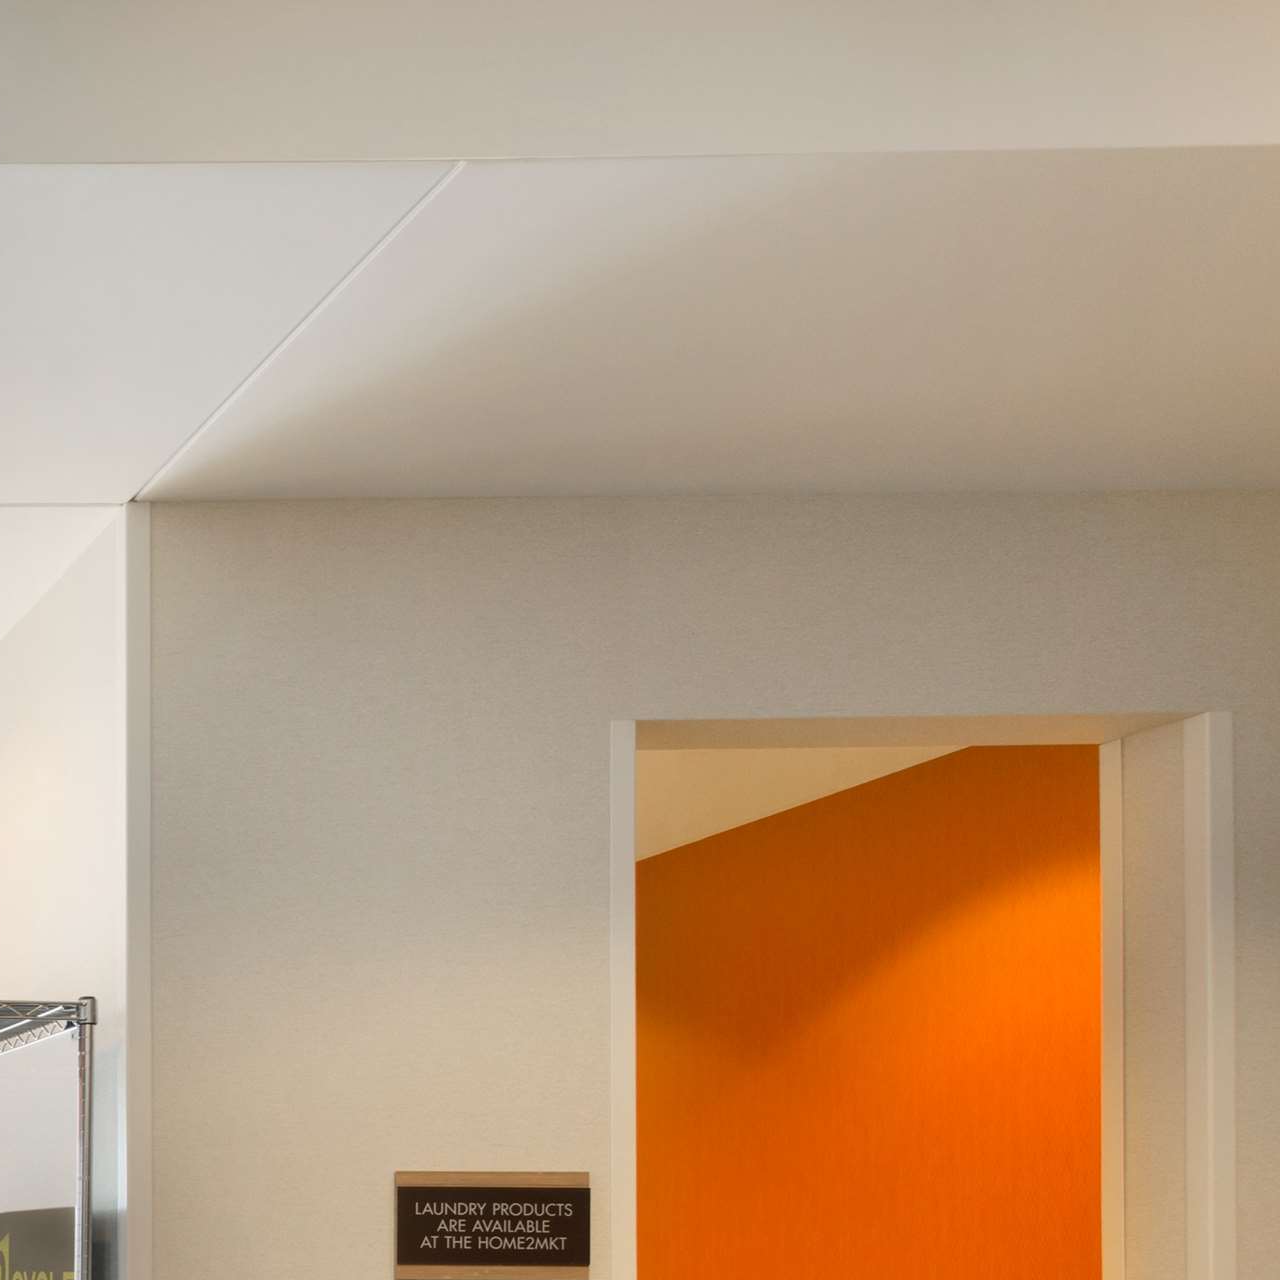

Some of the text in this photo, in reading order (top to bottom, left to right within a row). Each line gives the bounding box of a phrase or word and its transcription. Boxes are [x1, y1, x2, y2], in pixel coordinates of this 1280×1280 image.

[414, 1201, 573, 1218] LAUNDRY PRODUCTS
[436, 1219, 551, 1234] ARE AVAILABLE
[419, 1235, 568, 1251] AT THE HOME2MKT
